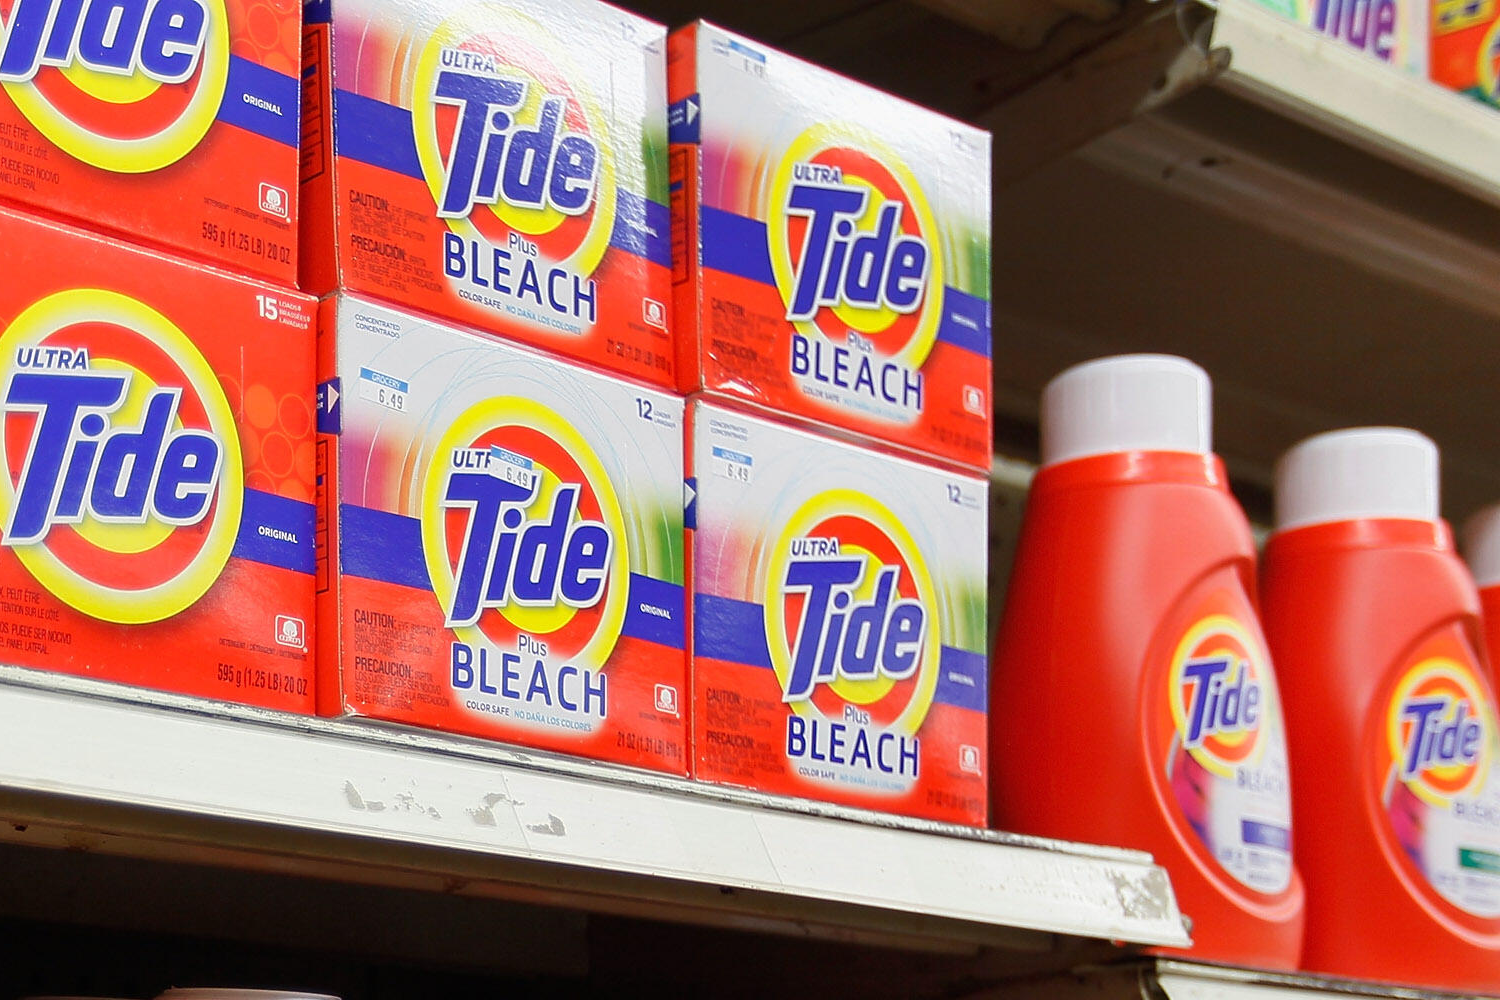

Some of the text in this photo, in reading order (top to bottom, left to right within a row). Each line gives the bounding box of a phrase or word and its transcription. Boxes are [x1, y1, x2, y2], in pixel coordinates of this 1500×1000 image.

[442, 50, 495, 73] ULTRA
[243, 94, 283, 116] ORIGINAL
[434, 69, 599, 219] Tide
[794, 164, 842, 185] ULTRA
[202, 221, 218, 242] 595
[228, 225, 249, 252] (1.25
[252, 236, 265, 259] LB)
[280, 246, 291, 264] OZ
[509, 232, 538, 257] Plus
[786, 184, 929, 322] Tide
[444, 231, 596, 323] BLEACH
[256, 295, 278, 321] 15
[459, 289, 502, 310] COLOR SAFE
[355, 314, 400, 331] CONCENTRATED
[355, 322, 400, 339] CONCENTRADO
[17, 348, 87, 370] ULTRA
[372, 373, 400, 389] GROCERY
[791, 333, 923, 411] BLEACH
[379, 388, 403, 410] 6.49
[636, 398, 652, 420] 12
[1, 371, 224, 545] Tide
[506, 467, 528, 487] 6.49
[258, 525, 298, 544] ORIGINAL
[441, 472, 613, 629] Tide
[791, 538, 839, 557] ULTRA
[640, 603, 671, 620] ORIGINAL
[782, 557, 928, 703] Tide
[518, 635, 547, 657] Plus
[218, 663, 234, 682] 595
[243, 667, 266, 689] (1.25
[268, 672, 282, 693] LB)
[284, 676, 294, 695] 20
[297, 679, 308, 696] OZ
[452, 642, 606, 717] BLEACH
[1182, 658, 1260, 743] Tide
[466, 700, 491, 713] COLOR
[492, 705, 510, 716] SAFE
[514, 710, 525, 719] NO
[547, 717, 560, 727] LOS
[844, 705, 869, 726] Plus
[786, 715, 919, 778] BLEACH
[1404, 701, 1481, 774] Tide
